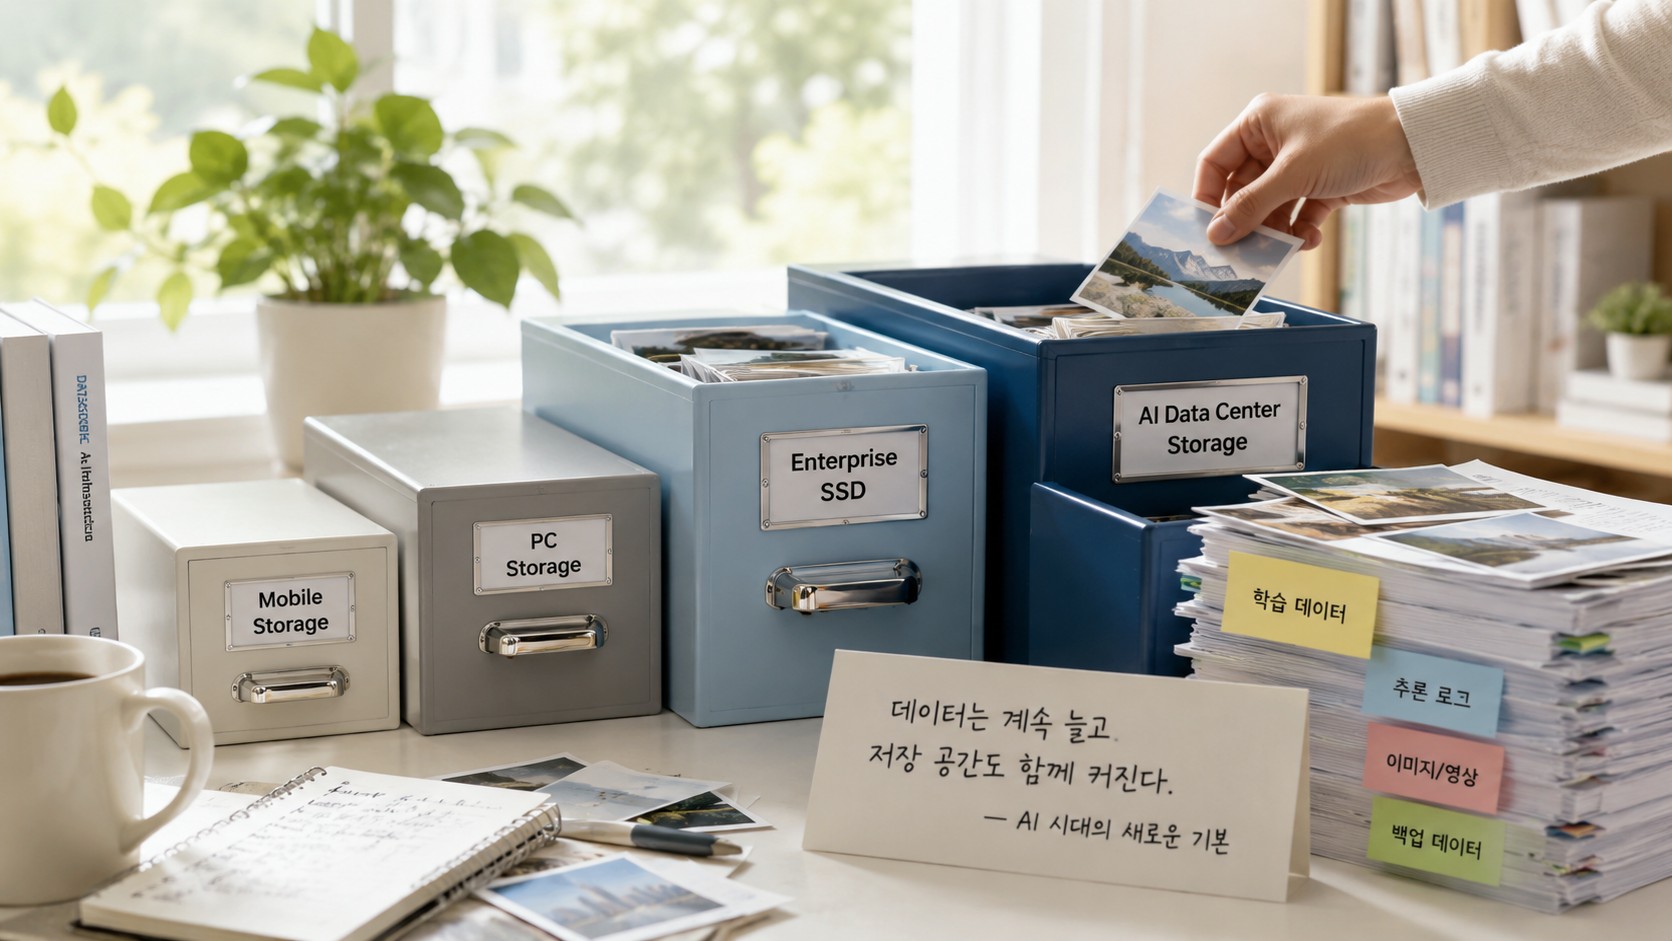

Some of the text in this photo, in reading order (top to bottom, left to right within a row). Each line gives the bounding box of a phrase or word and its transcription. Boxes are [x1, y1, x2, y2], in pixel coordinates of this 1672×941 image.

[1137, 401, 1282, 426] AI Data Center
[1167, 435, 1248, 457] Storage
[791, 447, 898, 474] Enterprise
[820, 480, 867, 502] SSD
[530, 531, 558, 550] PC
[506, 559, 582, 579] Storage
[258, 587, 323, 609] Mobile
[1253, 587, 1347, 625] 학습 데이터
[252, 616, 330, 636] Storage
[1392, 677, 1428, 703] 추론
[891, 698, 990, 732] 데이터는
[1002, 706, 1053, 741] 계속
[868, 742, 1173, 796] 저장 공간도 함께 커진다.
[1386, 753, 1479, 788] 이미지/영상
[1015, 810, 1040, 832] AI
[1049, 814, 1112, 841] 시대의
[1121, 821, 1182, 850] 새로운
[1192, 828, 1230, 856] 기본
[1391, 824, 1482, 861] 백업 데이터
